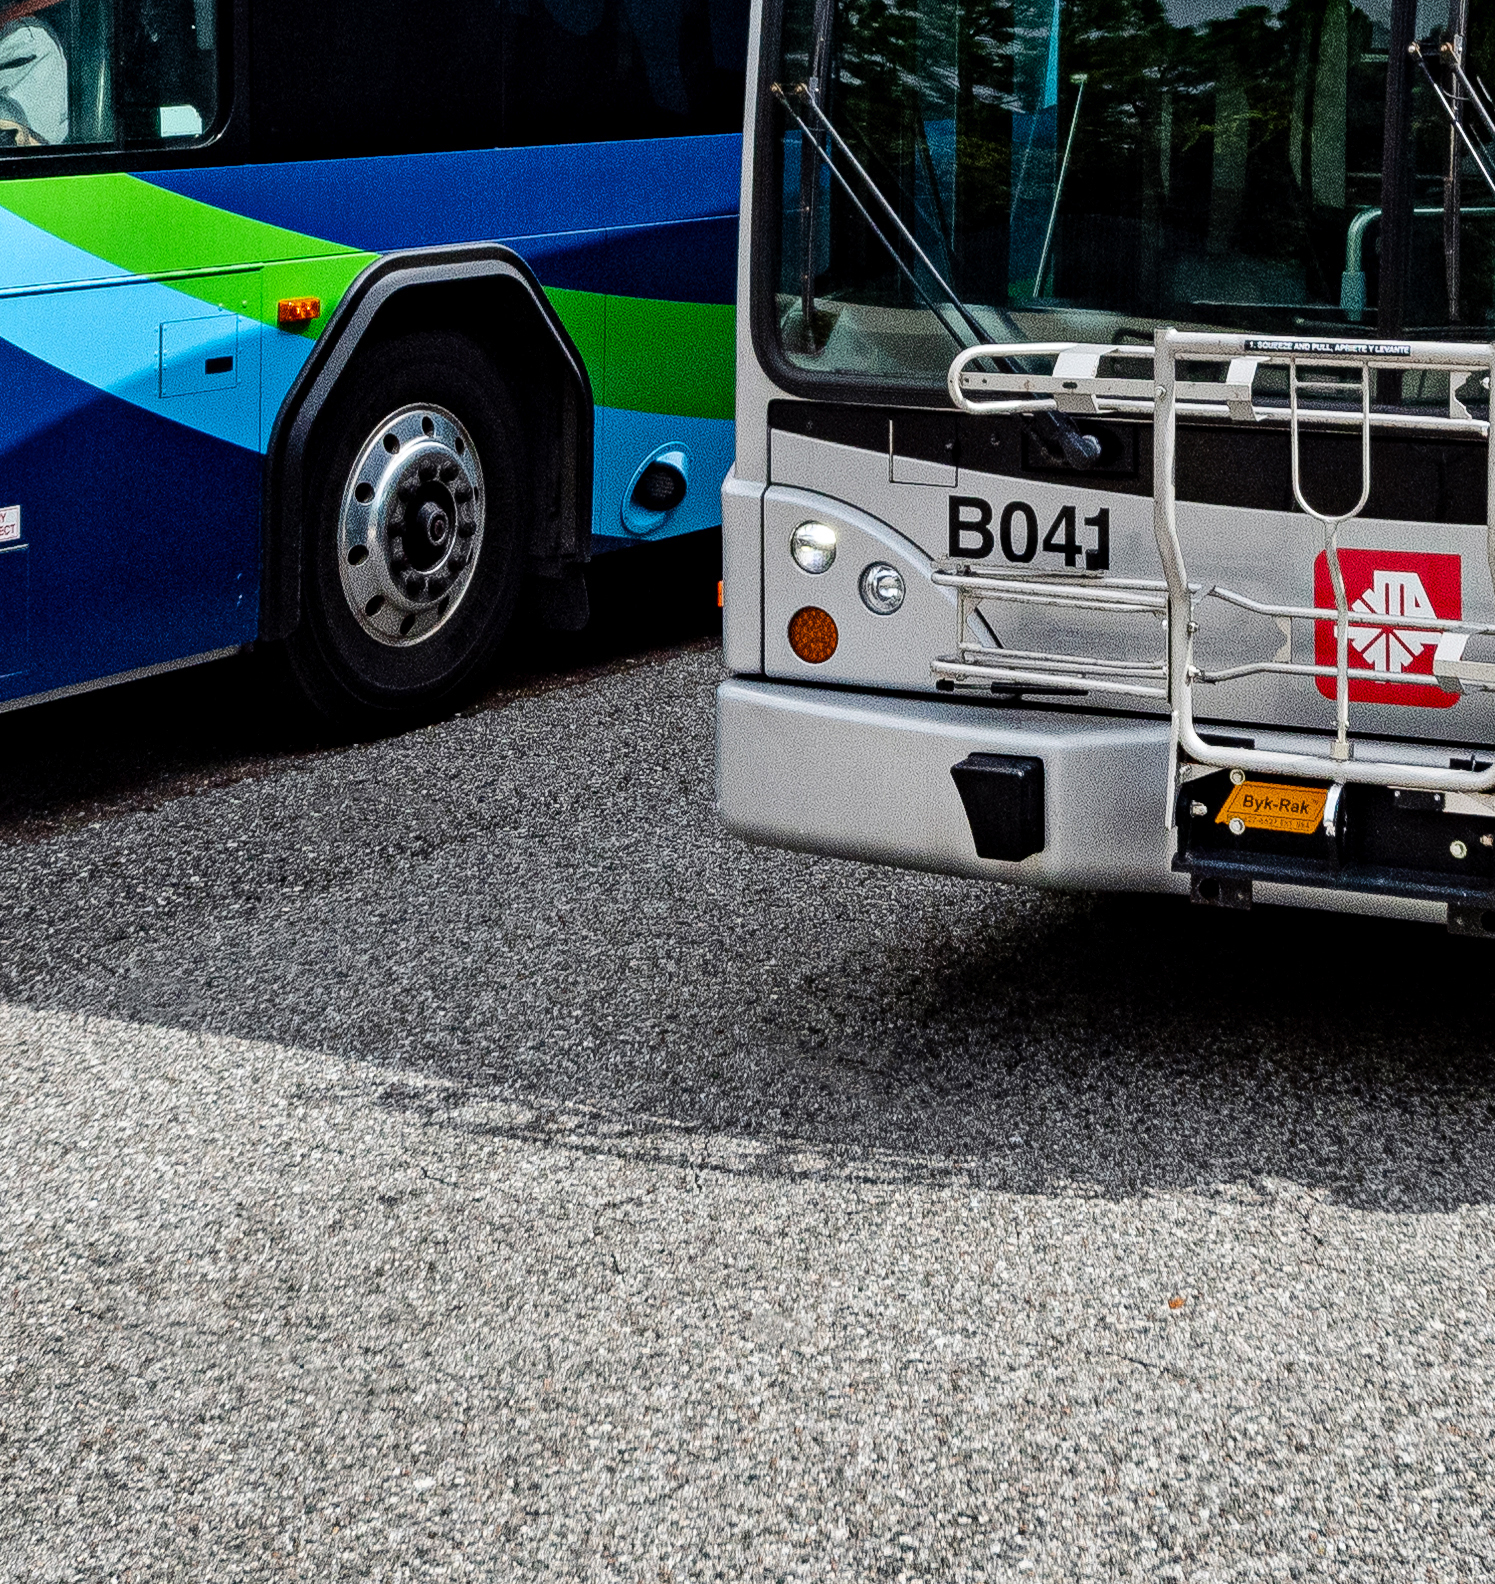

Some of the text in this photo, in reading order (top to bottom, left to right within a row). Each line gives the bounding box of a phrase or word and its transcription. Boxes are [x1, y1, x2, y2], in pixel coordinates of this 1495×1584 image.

[1294, 342, 1310, 352] AND
[1335, 344, 1367, 353] APRETE
[1368, 345, 1375, 353] Y
[1375, 345, 1410, 354] LEVANTE
[948, 495, 1110, 571] B041
[1242, 794, 1310, 815] Byk-Rak
